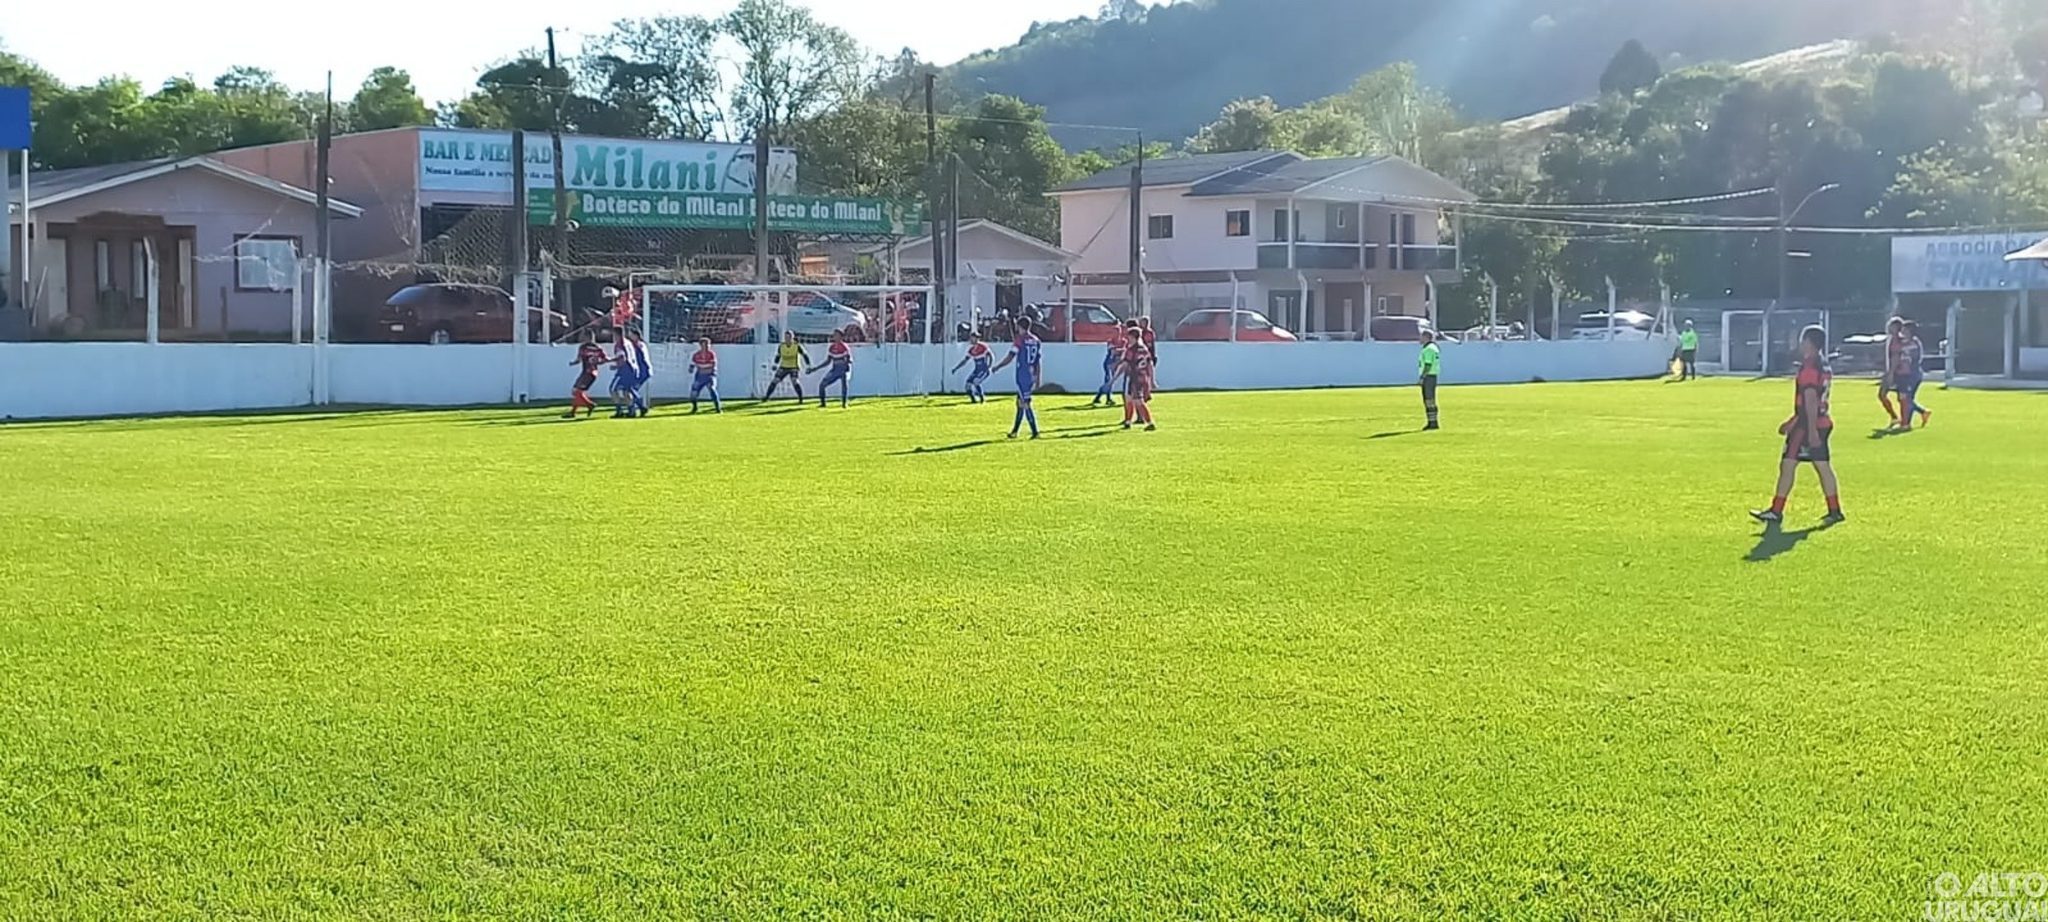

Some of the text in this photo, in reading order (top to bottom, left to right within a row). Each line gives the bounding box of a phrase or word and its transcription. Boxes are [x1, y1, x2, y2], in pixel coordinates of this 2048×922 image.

[423, 140, 459, 160] BAR
[463, 142, 476, 160] E
[571, 144, 718, 191] Milani
[582, 193, 651, 214] Boteco
[658, 196, 680, 215] do
[686, 196, 744, 216] Milani
[810, 200, 830, 219] do
[834, 201, 881, 221] Milani
[1026, 345, 1037, 364] 19
